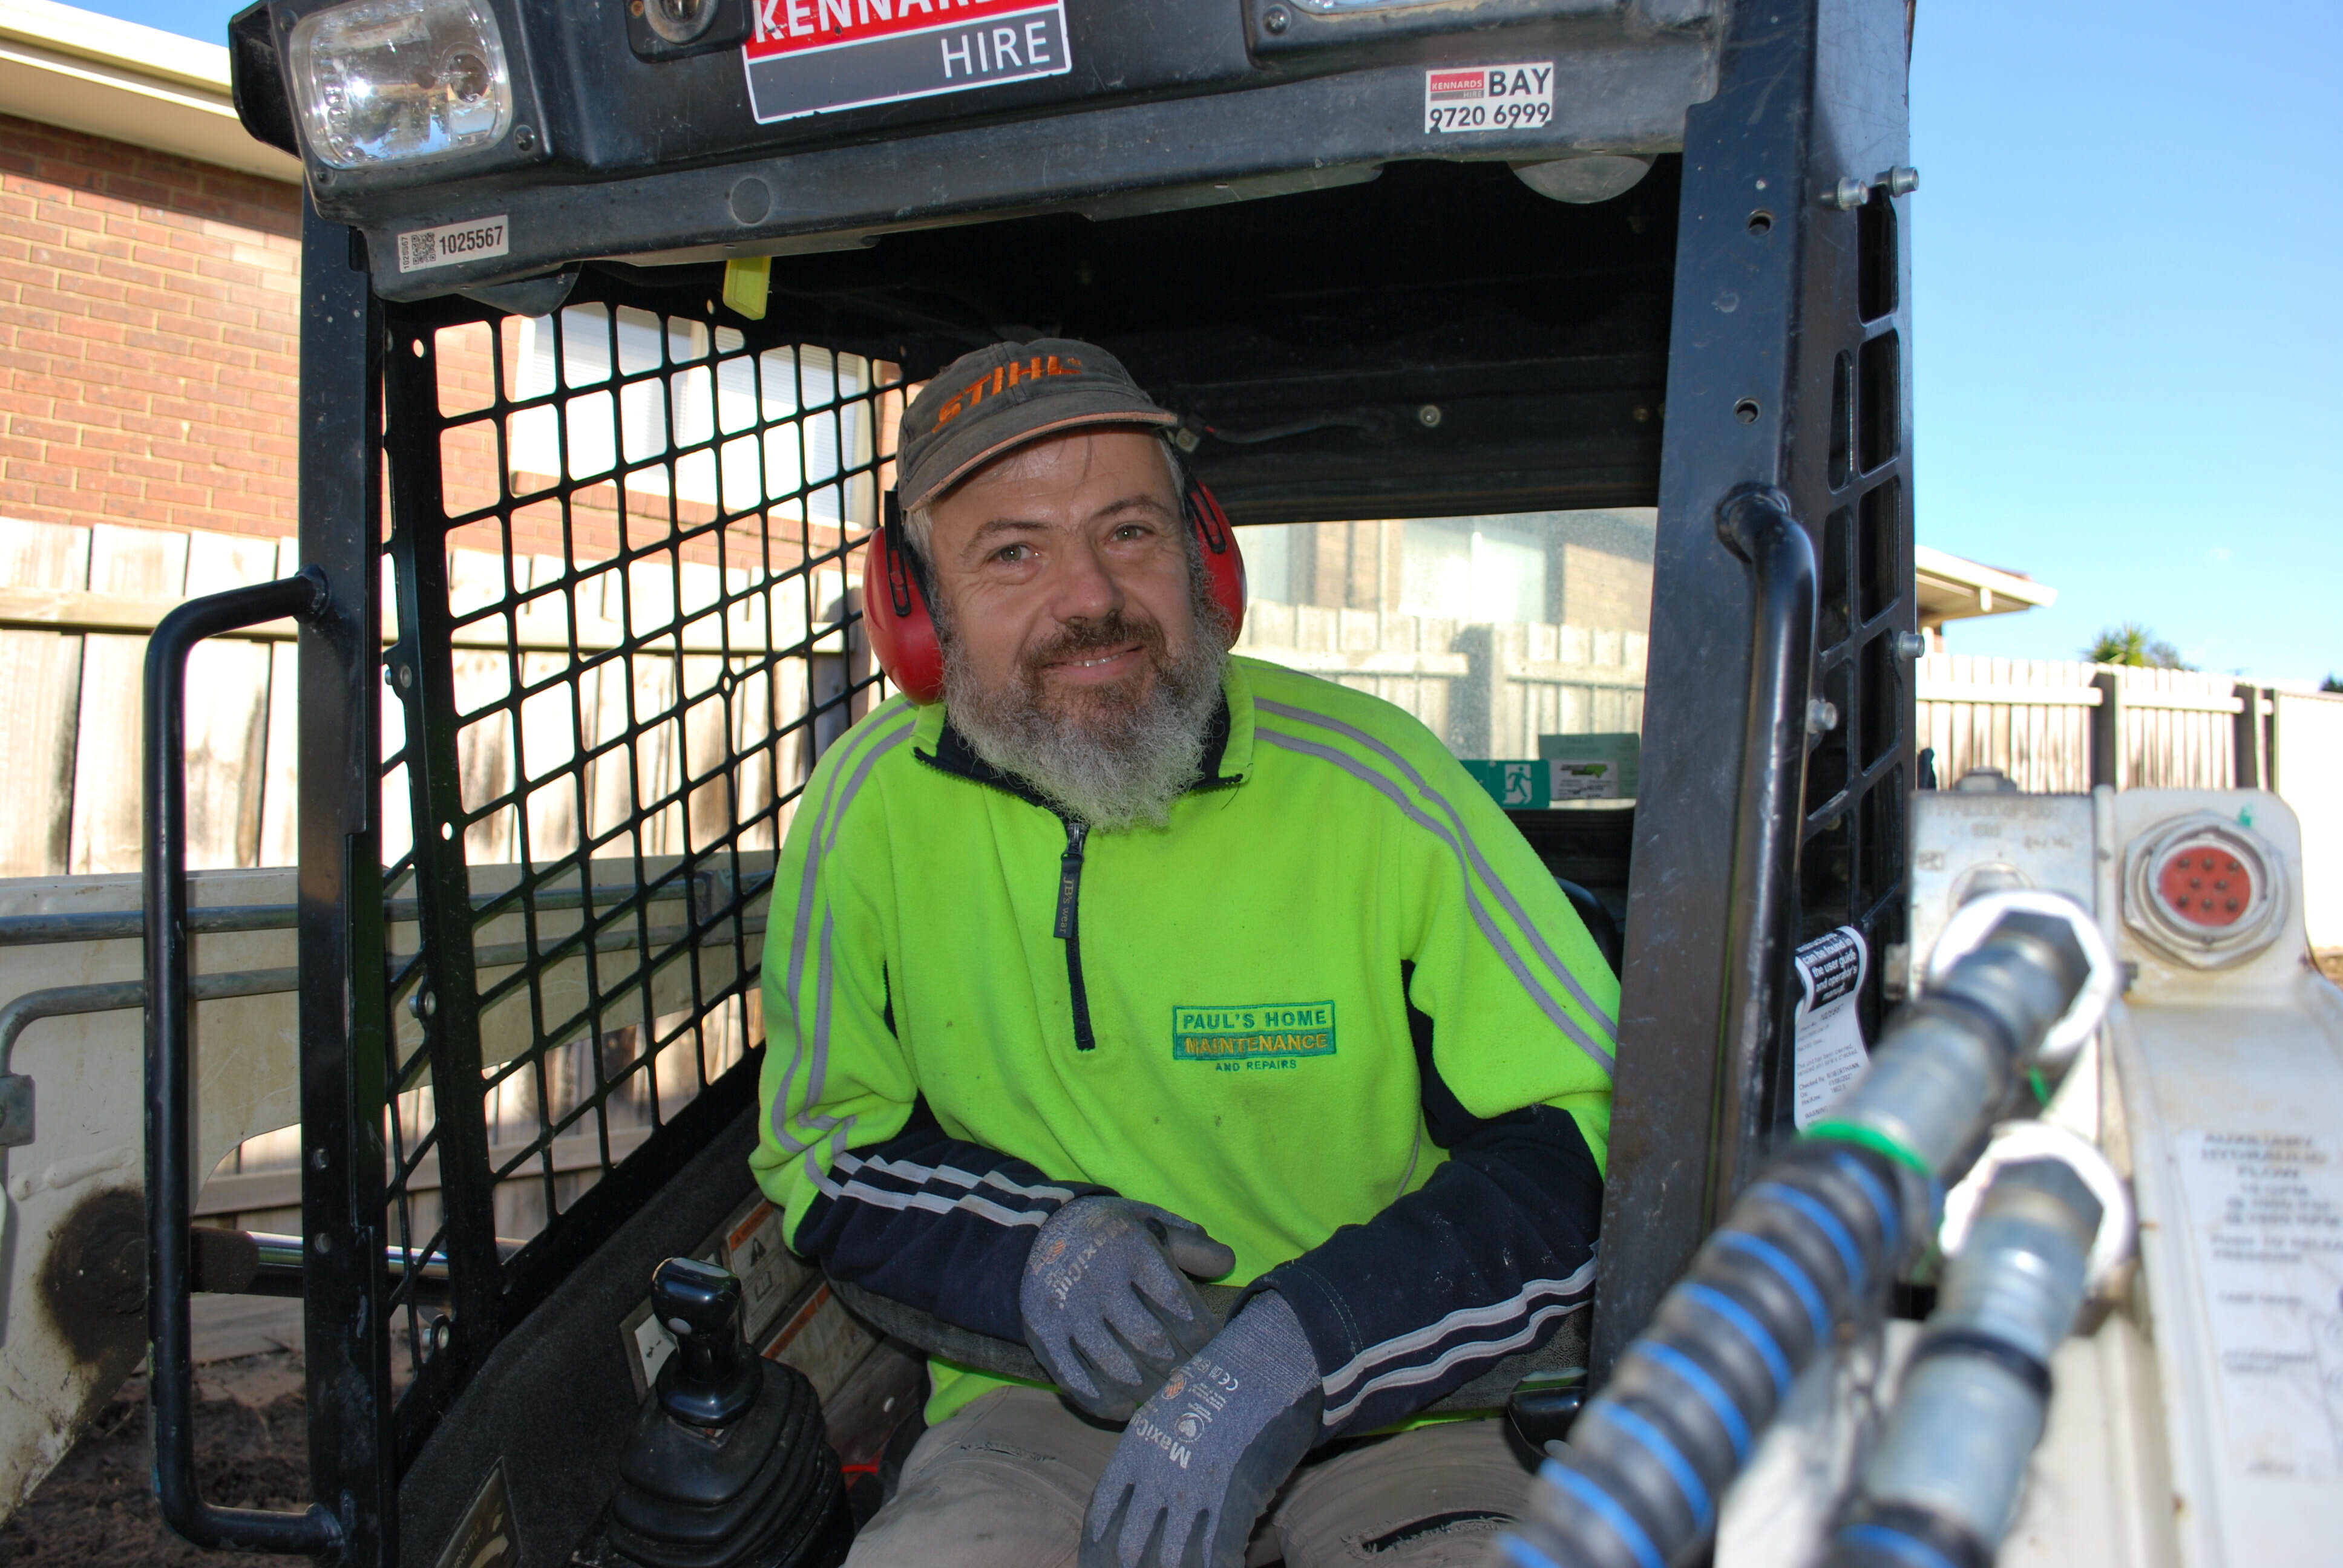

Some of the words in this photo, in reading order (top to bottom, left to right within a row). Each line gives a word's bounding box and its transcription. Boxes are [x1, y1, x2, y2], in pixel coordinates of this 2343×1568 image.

[753, 0, 994, 43] KENN
[941, 21, 1050, 78] HIRE
[1432, 79, 1483, 90] KENNARDS
[1489, 67, 1552, 97] BAY
[1429, 105, 1485, 128] 9720
[1493, 102, 1550, 126] 6999
[439, 225, 503, 255] 1025567
[932, 355, 1082, 433] STIHL
[1063, 875, 1074, 904] JB's
[1060, 907, 1069, 934] wear
[1803, 954, 1818, 965] can
[1814, 950, 1827, 959] be
[1823, 939, 1846, 955] found
[1842, 937, 1853, 947] in
[1812, 966, 1824, 978] the
[1823, 959, 1838, 973] user
[1838, 949, 1856, 969] guide
[1816, 978, 1827, 993] and
[1183, 1013, 1255, 1030] PAUL'S
[1265, 1010, 1327, 1027] HOME
[1184, 1033, 1328, 1054] MAINTENANCE
[1216, 1062, 1240, 1072] AND
[1247, 1059, 1297, 1070] REPAIRS
[1130, 1413, 1191, 1469] MaxiCu
